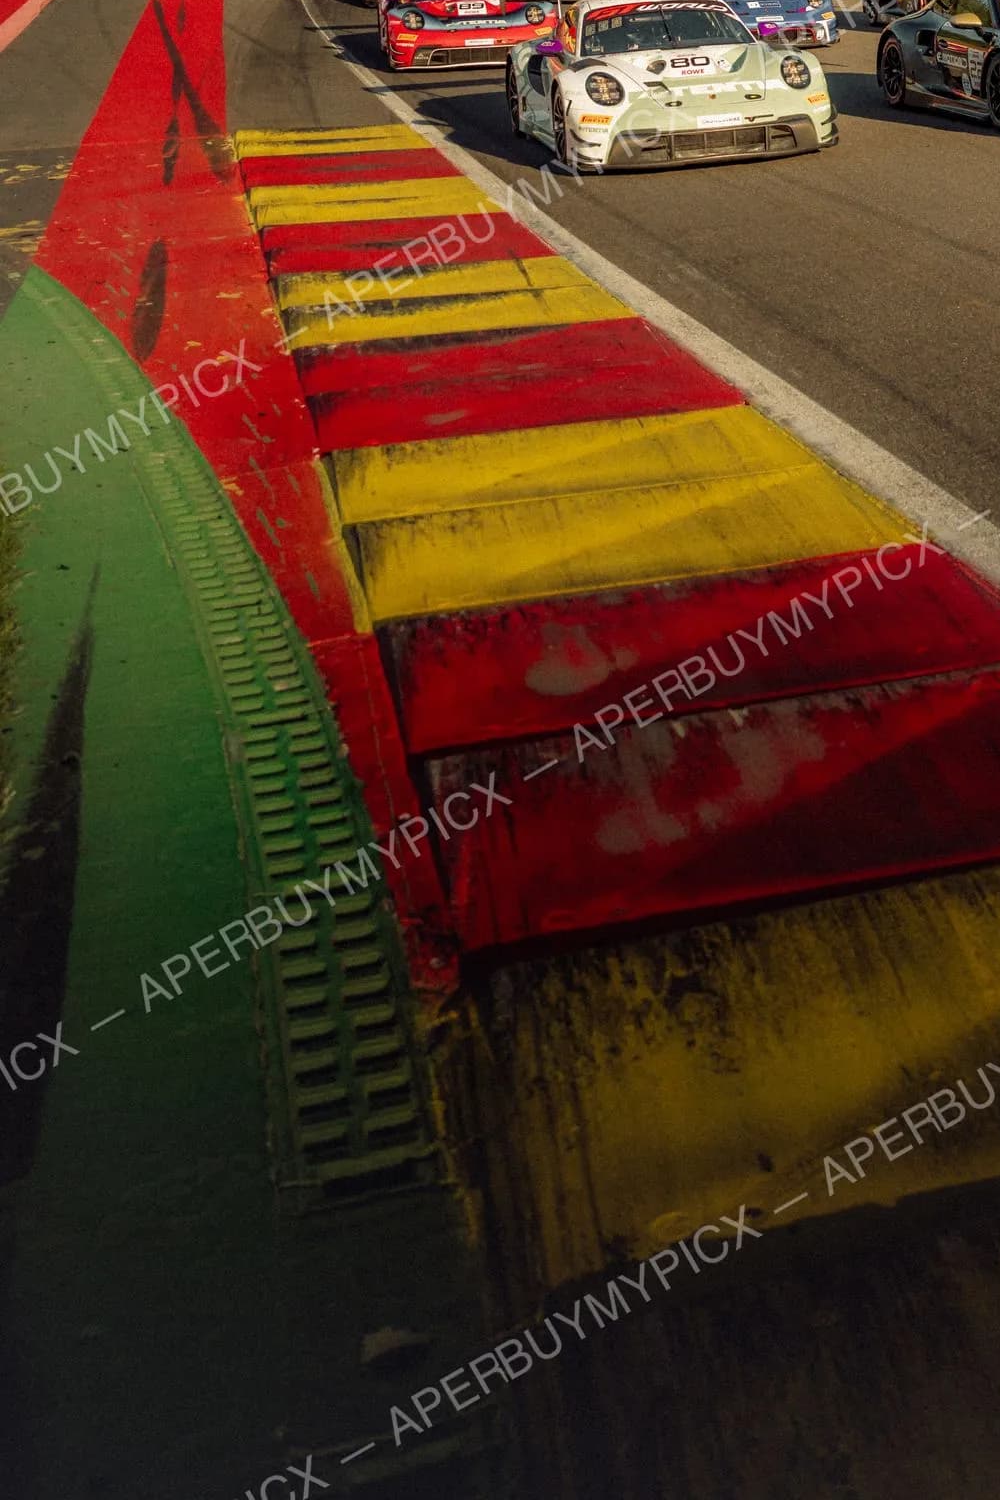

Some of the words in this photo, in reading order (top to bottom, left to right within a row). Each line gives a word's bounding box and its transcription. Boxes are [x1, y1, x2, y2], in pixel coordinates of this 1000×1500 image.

[586, 3, 640, 21] GT
[638, 0, 729, 13] WORLD
[670, 56, 710, 69] 80
[581, 115, 610, 123] PIRELLI
